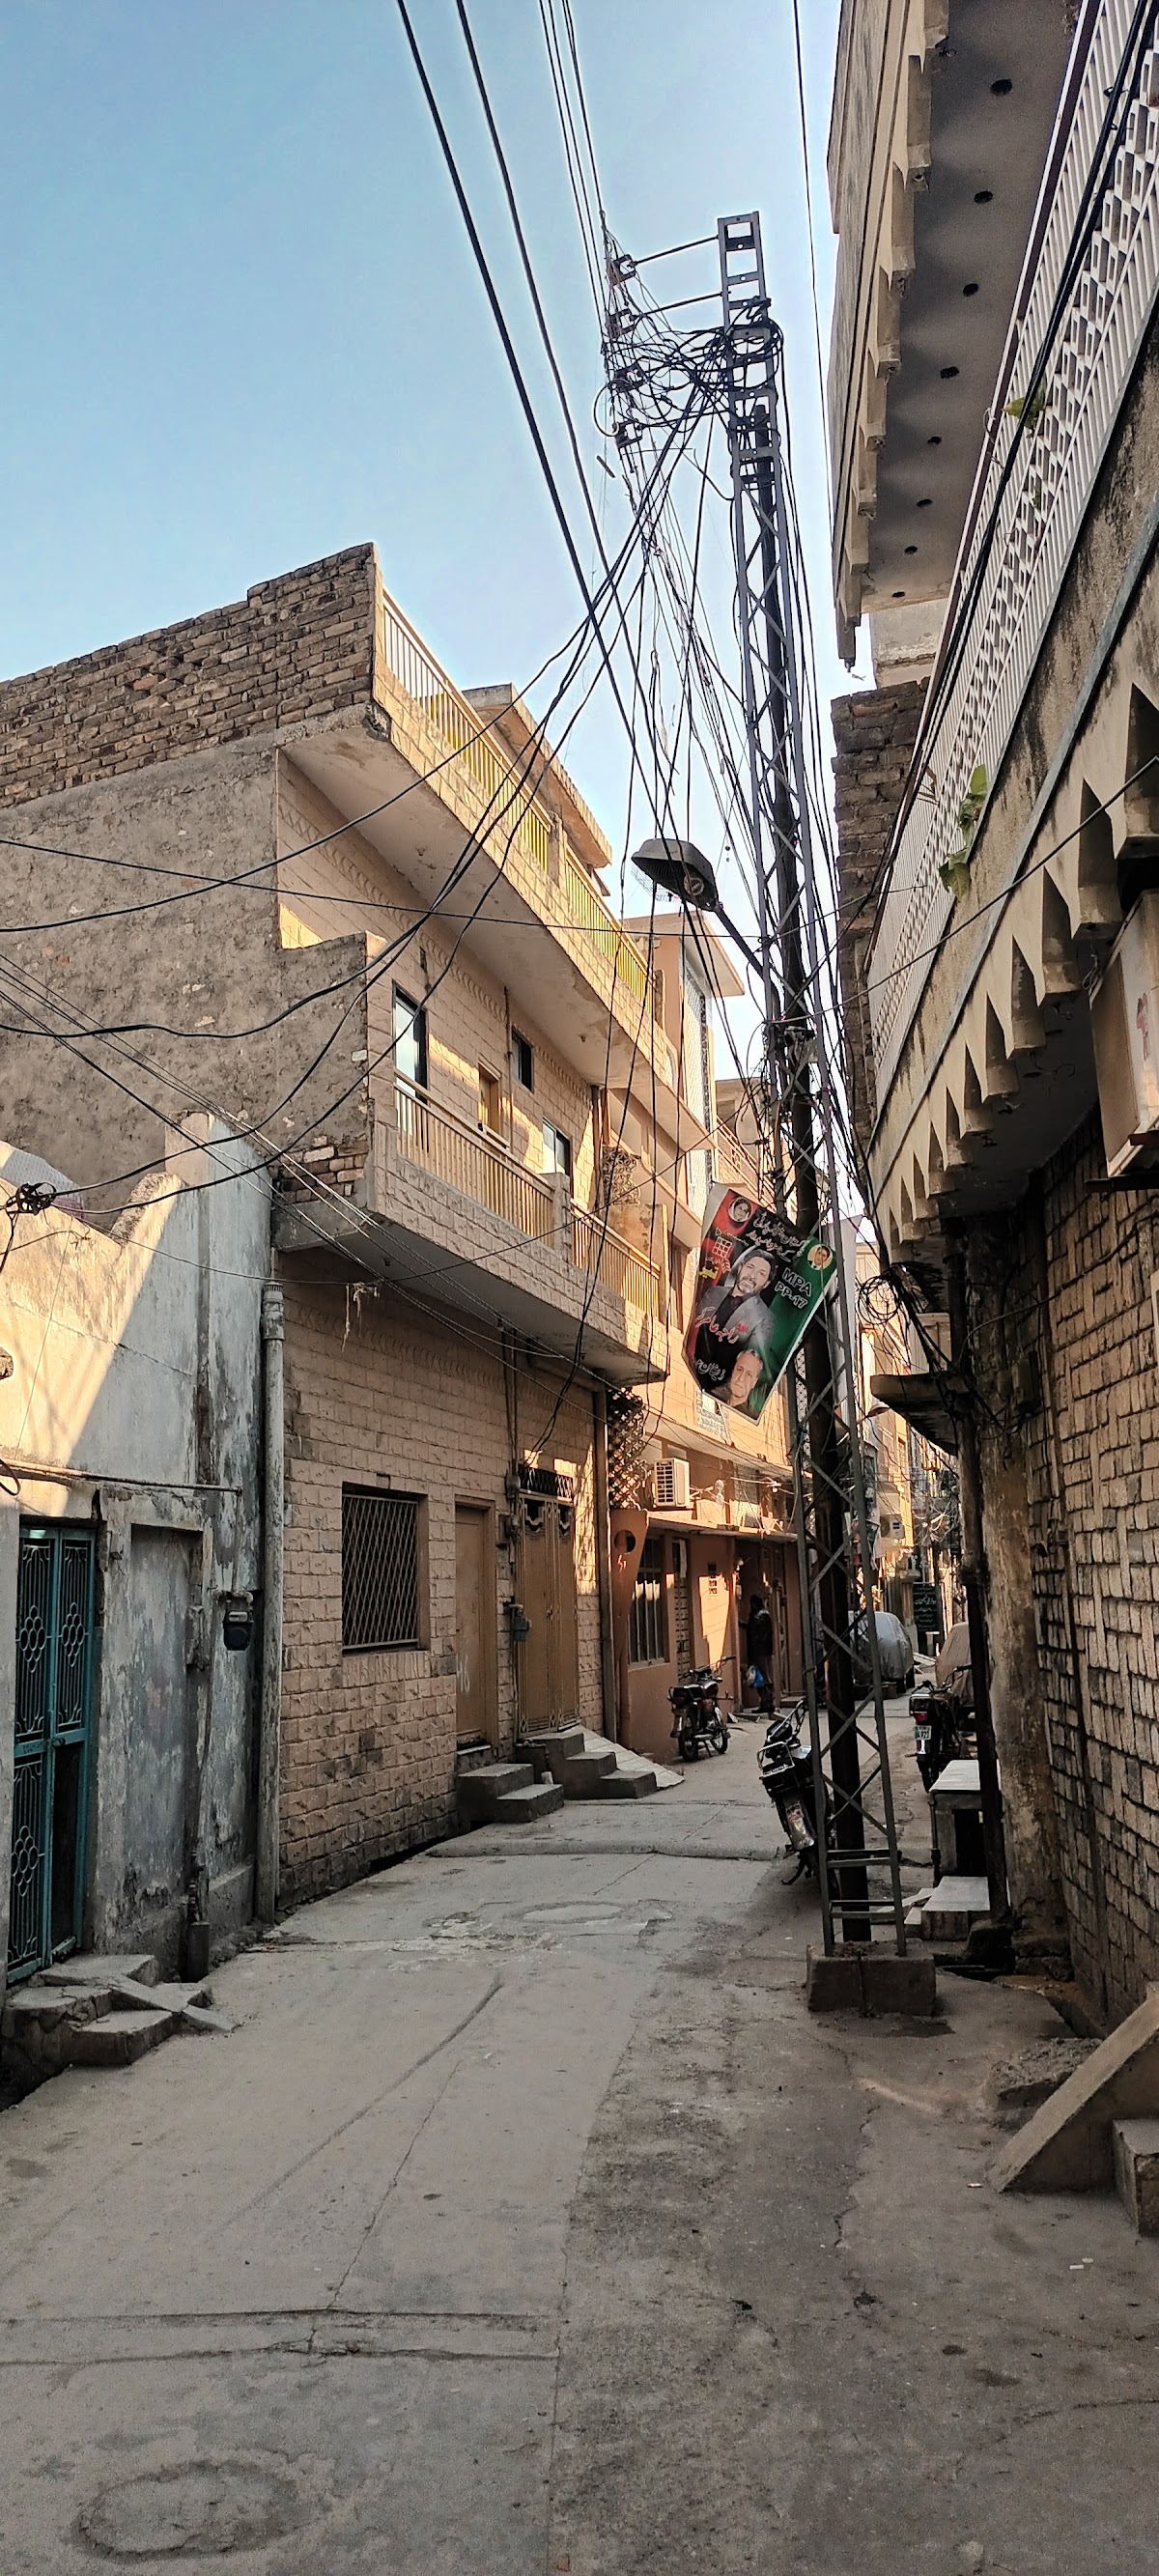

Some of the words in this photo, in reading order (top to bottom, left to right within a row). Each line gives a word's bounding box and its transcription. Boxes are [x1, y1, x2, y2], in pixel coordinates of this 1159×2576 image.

[781, 1267, 812, 1297] MPA
[775, 1281, 808, 1309] PP-17
[694, 1315, 720, 1333] عامر
[715, 1327, 740, 1344] راجہ
